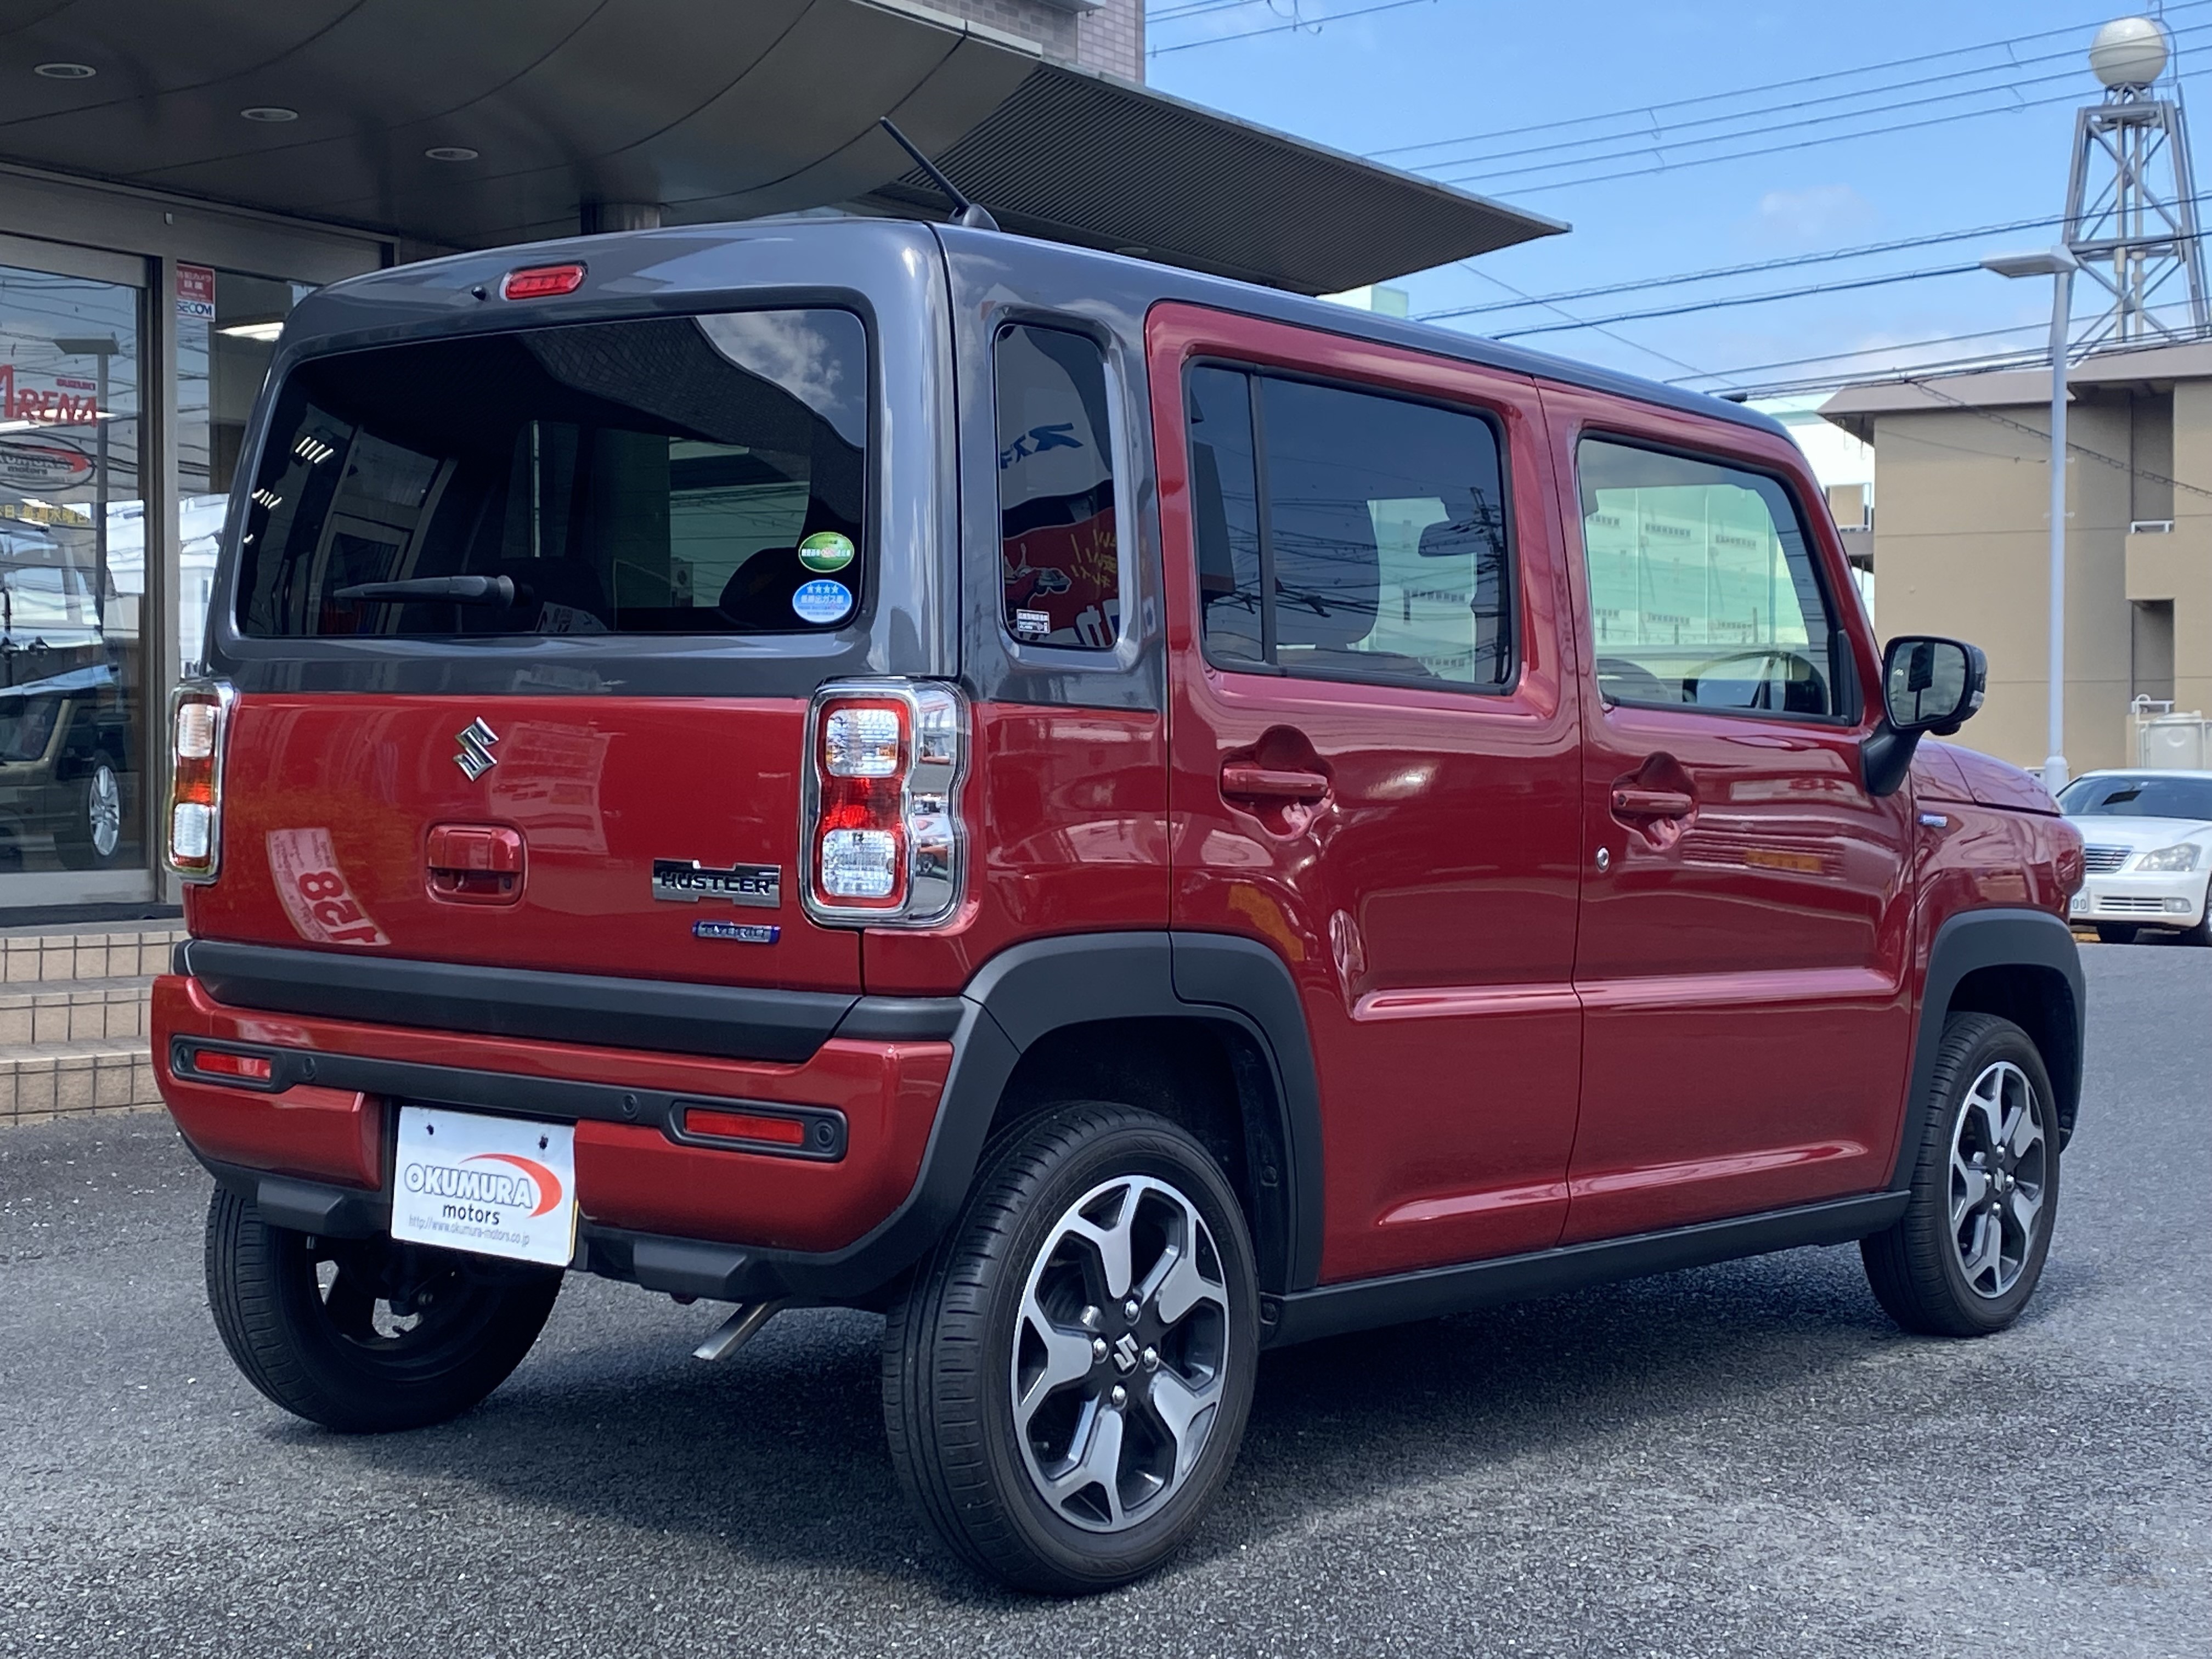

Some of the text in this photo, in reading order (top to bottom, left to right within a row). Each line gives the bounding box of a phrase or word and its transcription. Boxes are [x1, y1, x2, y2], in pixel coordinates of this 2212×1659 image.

[660, 871, 770, 895] HUSTLER
[404, 1162, 533, 1209] OKUMURA
[442, 1204, 500, 1226] motors
